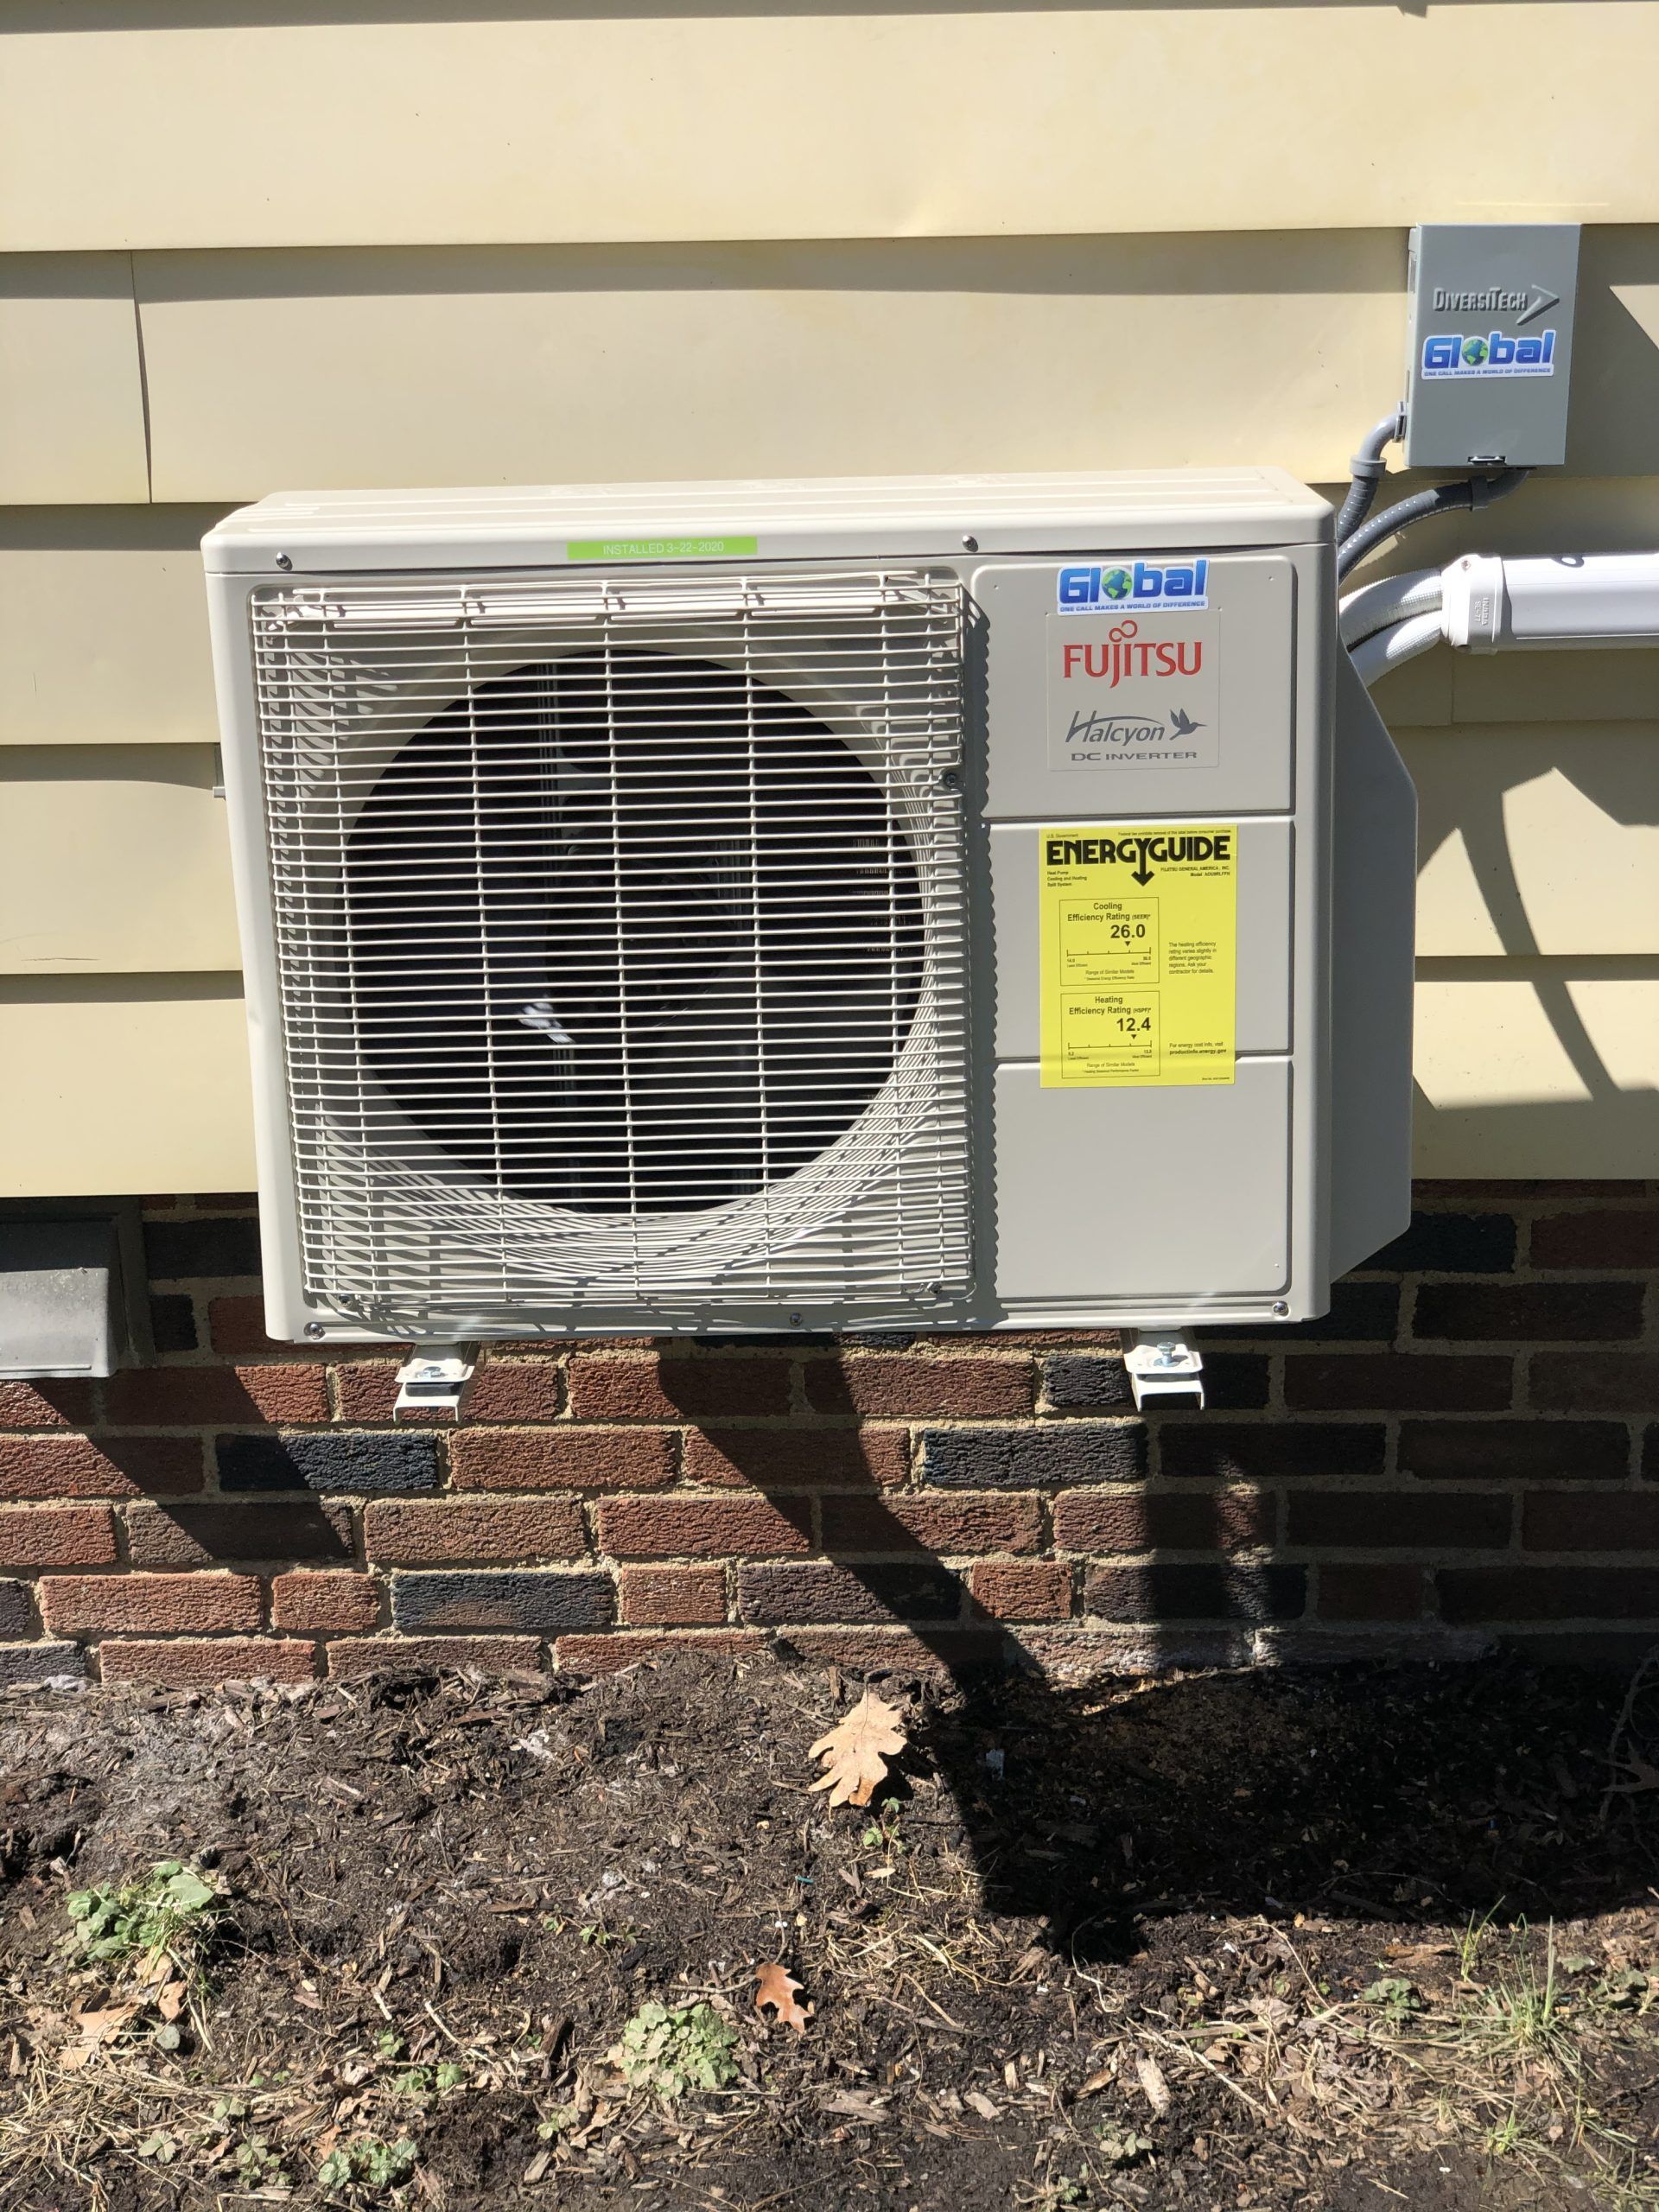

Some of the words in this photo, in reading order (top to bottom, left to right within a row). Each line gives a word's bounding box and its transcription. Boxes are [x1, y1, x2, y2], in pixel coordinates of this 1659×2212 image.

[1424, 332, 1554, 369] Global
[603, 543, 664, 556] INSTALLED
[666, 541, 724, 553] 3-22-2020
[1059, 560, 1207, 603] Global
[1063, 641, 1203, 689] FUJITSU
[1065, 710, 1166, 747] Halcyon
[1071, 753, 1102, 761] DC
[1105, 752, 1198, 761] INVERTER
[1093, 902, 1122, 911] Cooling
[1067, 913, 1103, 922] Efficiency
[1106, 912, 1130, 921] Rating
[1110, 924, 1146, 938] 26.0
[1095, 995, 1123, 1005] Heating
[1069, 1007, 1105, 1015] Efficiency
[1108, 1006, 1131, 1014] Rating
[1116, 1017, 1152, 1032] 12.4
